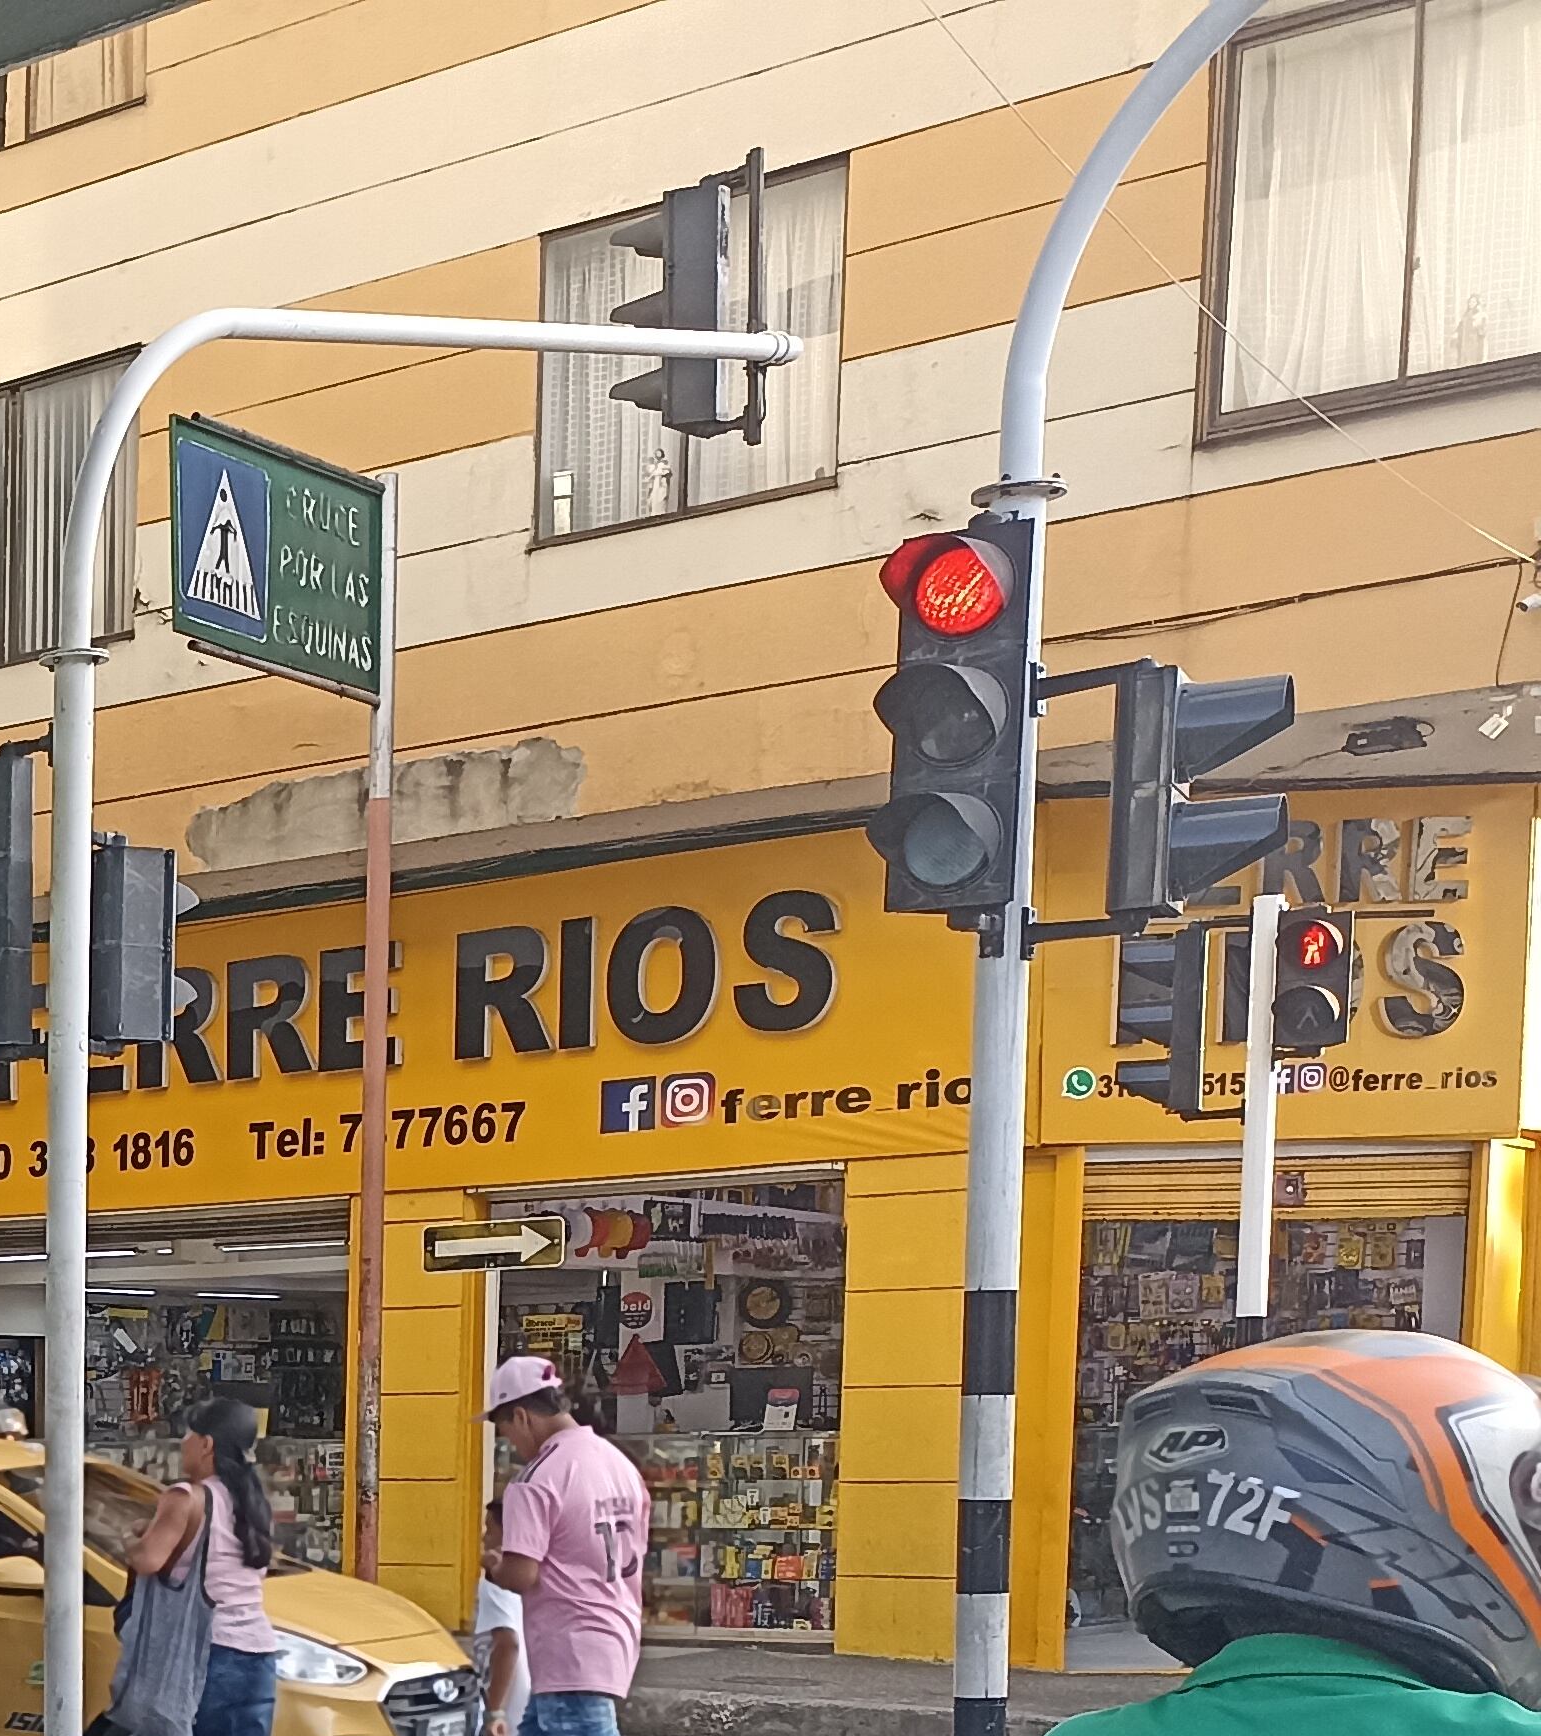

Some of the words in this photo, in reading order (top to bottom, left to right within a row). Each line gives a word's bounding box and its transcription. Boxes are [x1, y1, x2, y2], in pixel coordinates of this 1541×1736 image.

[286, 485, 360, 546] CRUCE
[280, 544, 324, 594] POR
[331, 560, 370, 607] LAS
[272, 604, 372, 672] ESQUINAS
[454, 889, 841, 1060] RIOS
[1328, 1066, 1498, 1095] @ferre_rios
[113, 1127, 195, 1171] 1816
[248, 1117, 326, 1161] Tel:
[339, 1100, 527, 1153] 777667
[1206, 1468, 1302, 1542] 72F
